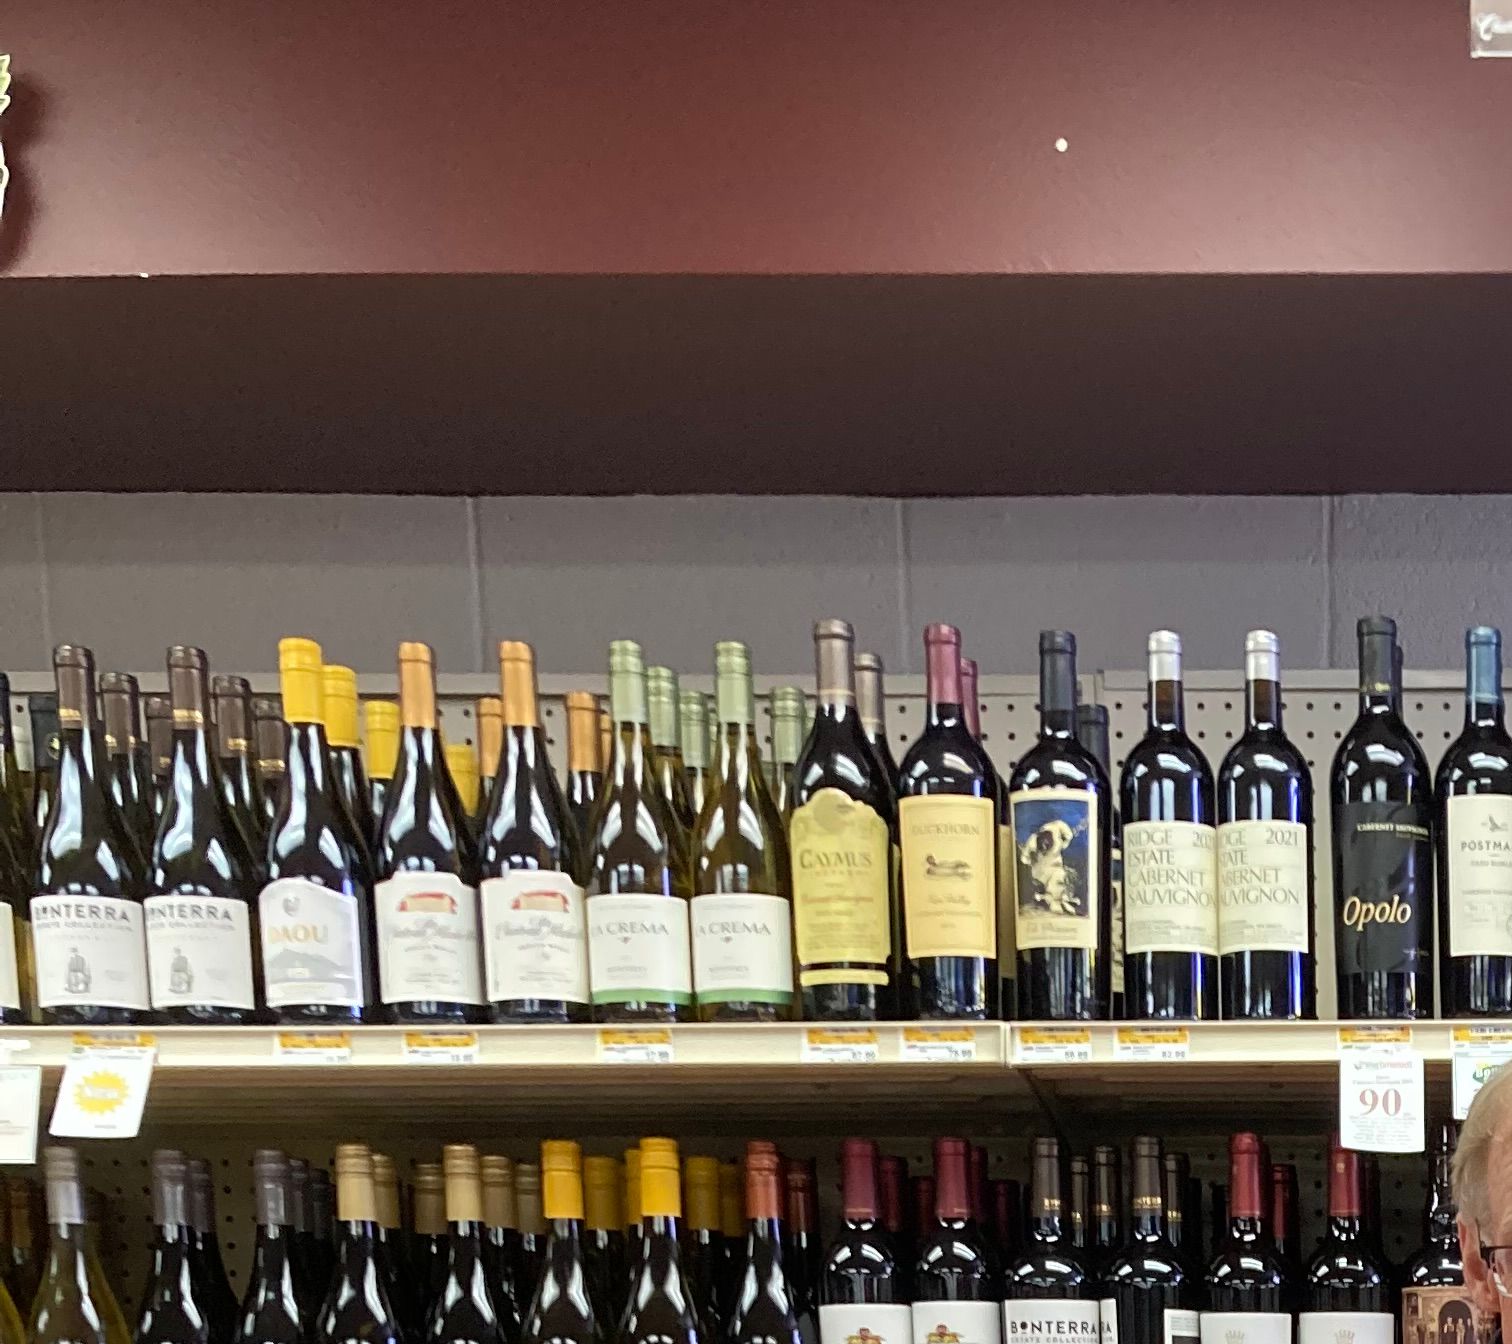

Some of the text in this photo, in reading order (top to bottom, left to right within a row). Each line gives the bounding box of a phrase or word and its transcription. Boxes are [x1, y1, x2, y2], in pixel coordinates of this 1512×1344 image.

[911, 824, 981, 836] DUCKHORN
[1128, 829, 1173, 847] RIDGE
[1266, 829, 1298, 847] 2021
[801, 850, 873, 868] CAYMUS
[1128, 849, 1175, 866] ESTATE
[1128, 868, 1206, 887] CABERNET
[1343, 894, 1412, 932] Opolo
[268, 924, 328, 943] DAOU
[606, 921, 670, 936] CREMA
[708, 921, 772, 936] CREMA
[1359, 1088, 1402, 1117] 90
